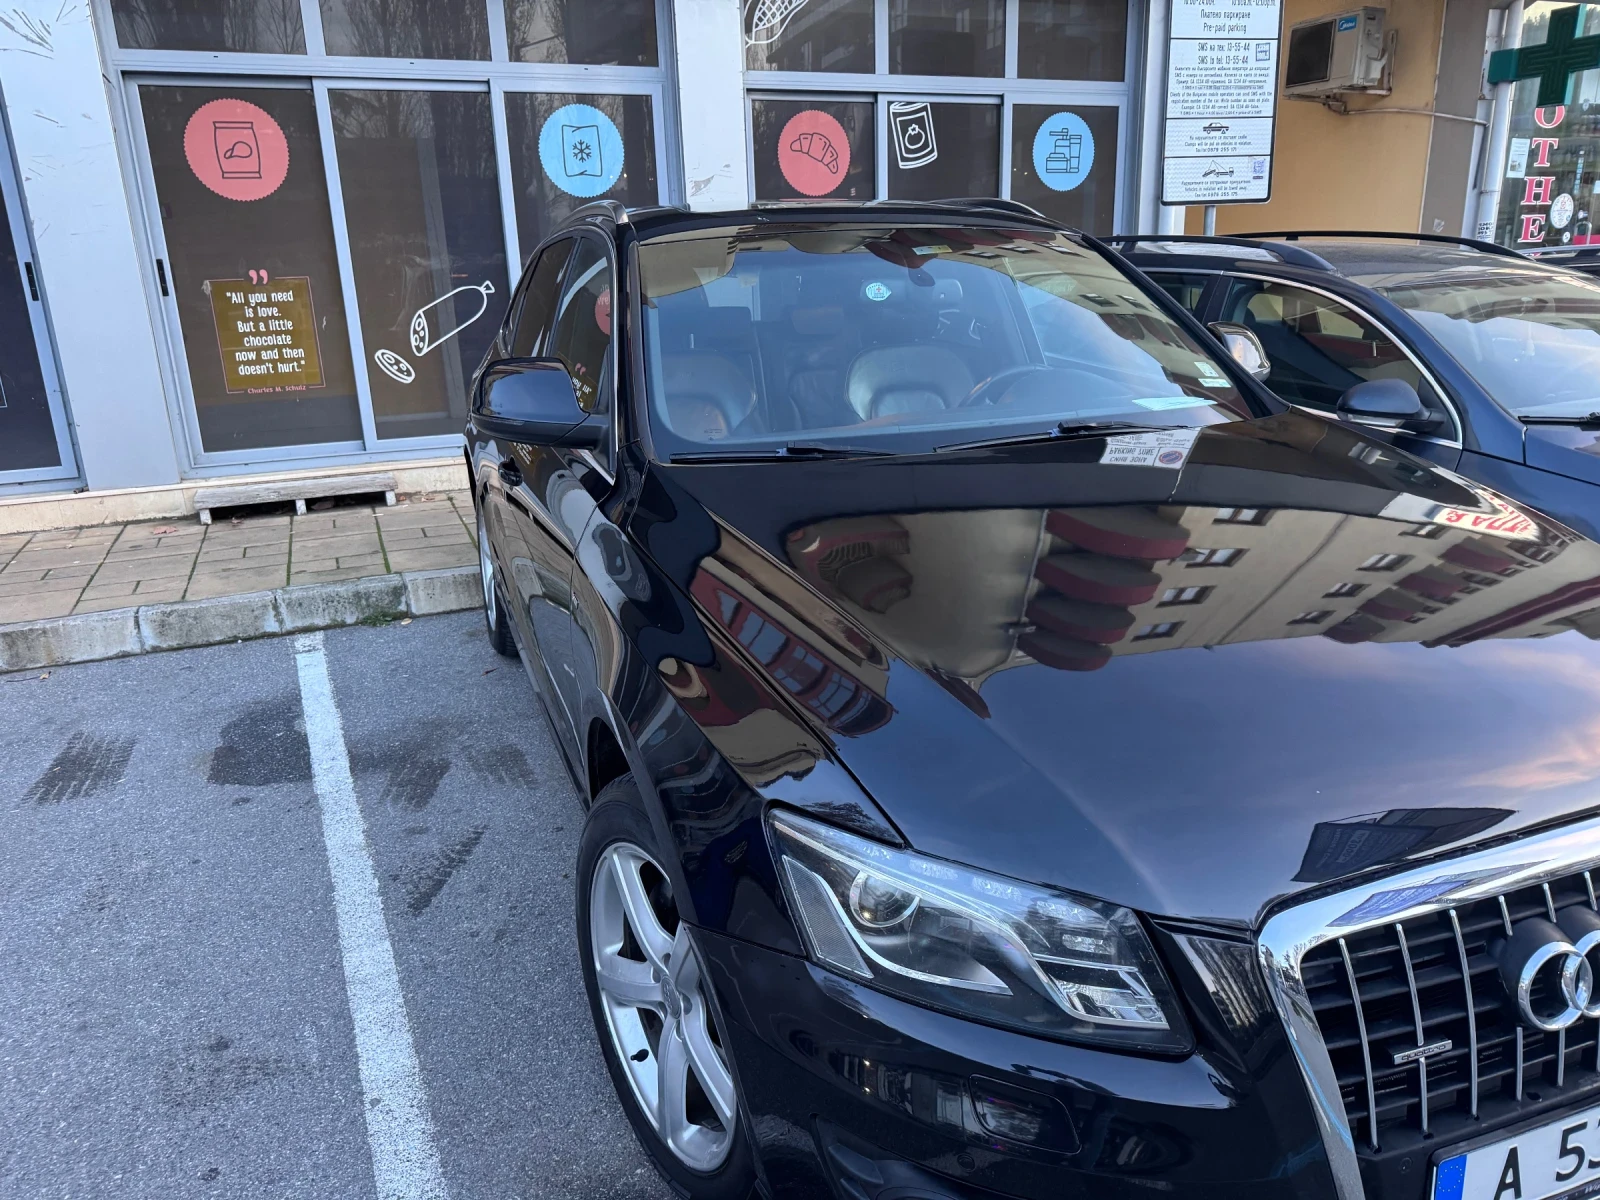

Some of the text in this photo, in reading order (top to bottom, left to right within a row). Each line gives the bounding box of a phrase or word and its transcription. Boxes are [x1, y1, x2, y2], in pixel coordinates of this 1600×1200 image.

[1200, 8, 1251, 20] Платено паркиране
[1203, 22, 1248, 34] Pre-paid parking
[1198, 42, 1208, 52] SMS
[1227, 42, 1250, 52] 13-55-44
[1198, 55, 1208, 64] SMS
[1210, 55, 1215, 64] to
[1226, 55, 1249, 64] 13-55-44
[226, 290, 294, 306] "All you need
[244, 306, 282, 318] is love.
[237, 319, 293, 332] But a little
[244, 334, 292, 346] chocolate
[236, 348, 304, 361] now and then
[238, 360, 306, 375] doesn't hurt."
[1494, 1146, 1522, 1200] A
